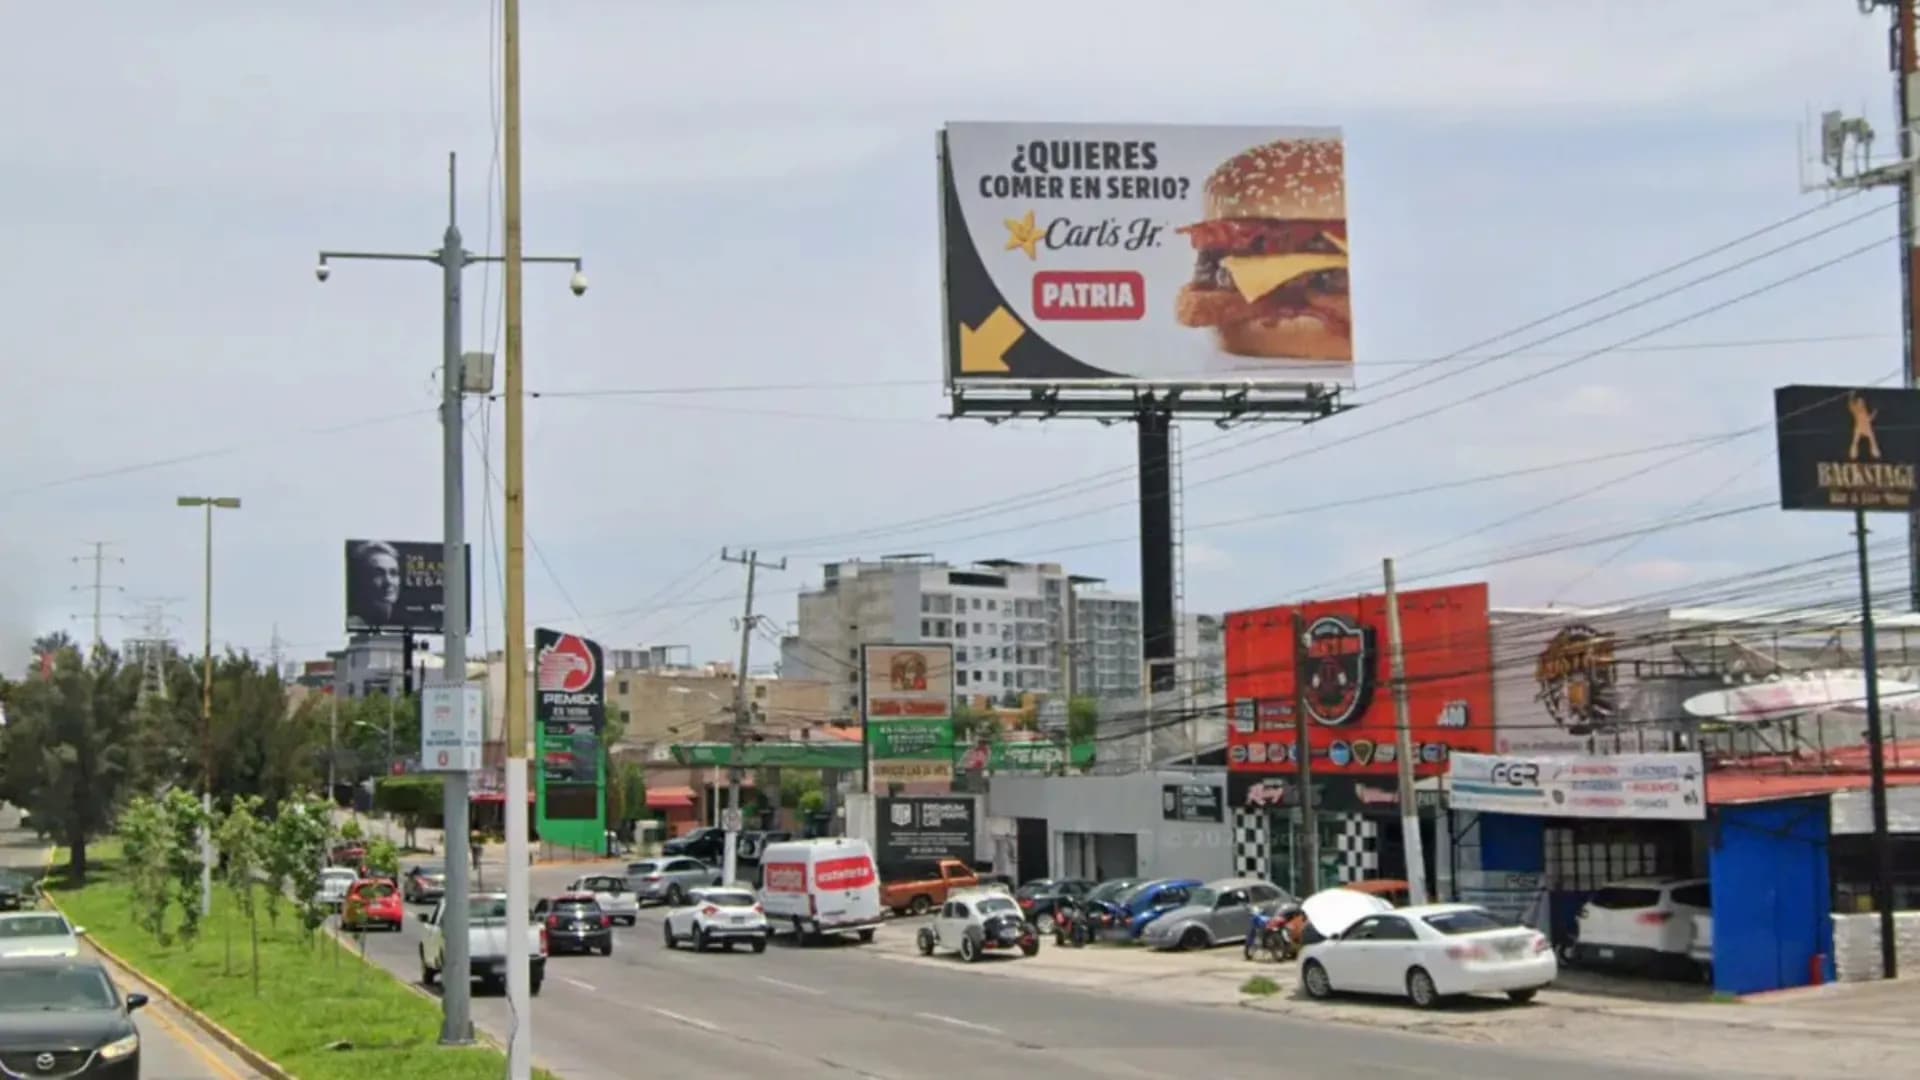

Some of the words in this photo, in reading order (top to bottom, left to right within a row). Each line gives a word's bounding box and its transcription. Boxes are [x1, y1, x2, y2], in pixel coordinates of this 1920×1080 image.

[1011, 141, 1158, 173] ¿QUIERES
[979, 175, 1063, 198] COMER
[1070, 176, 1101, 199] EN
[1107, 176, 1190, 200] SERIO?
[1044, 217, 1121, 250] Carl's
[1124, 217, 1163, 250] Jr.
[1042, 283, 1135, 308] PATRIA
[406, 561, 446, 571] GRAN
[406, 576, 444, 587] LEGA
[543, 693, 599, 705] PEMEX
